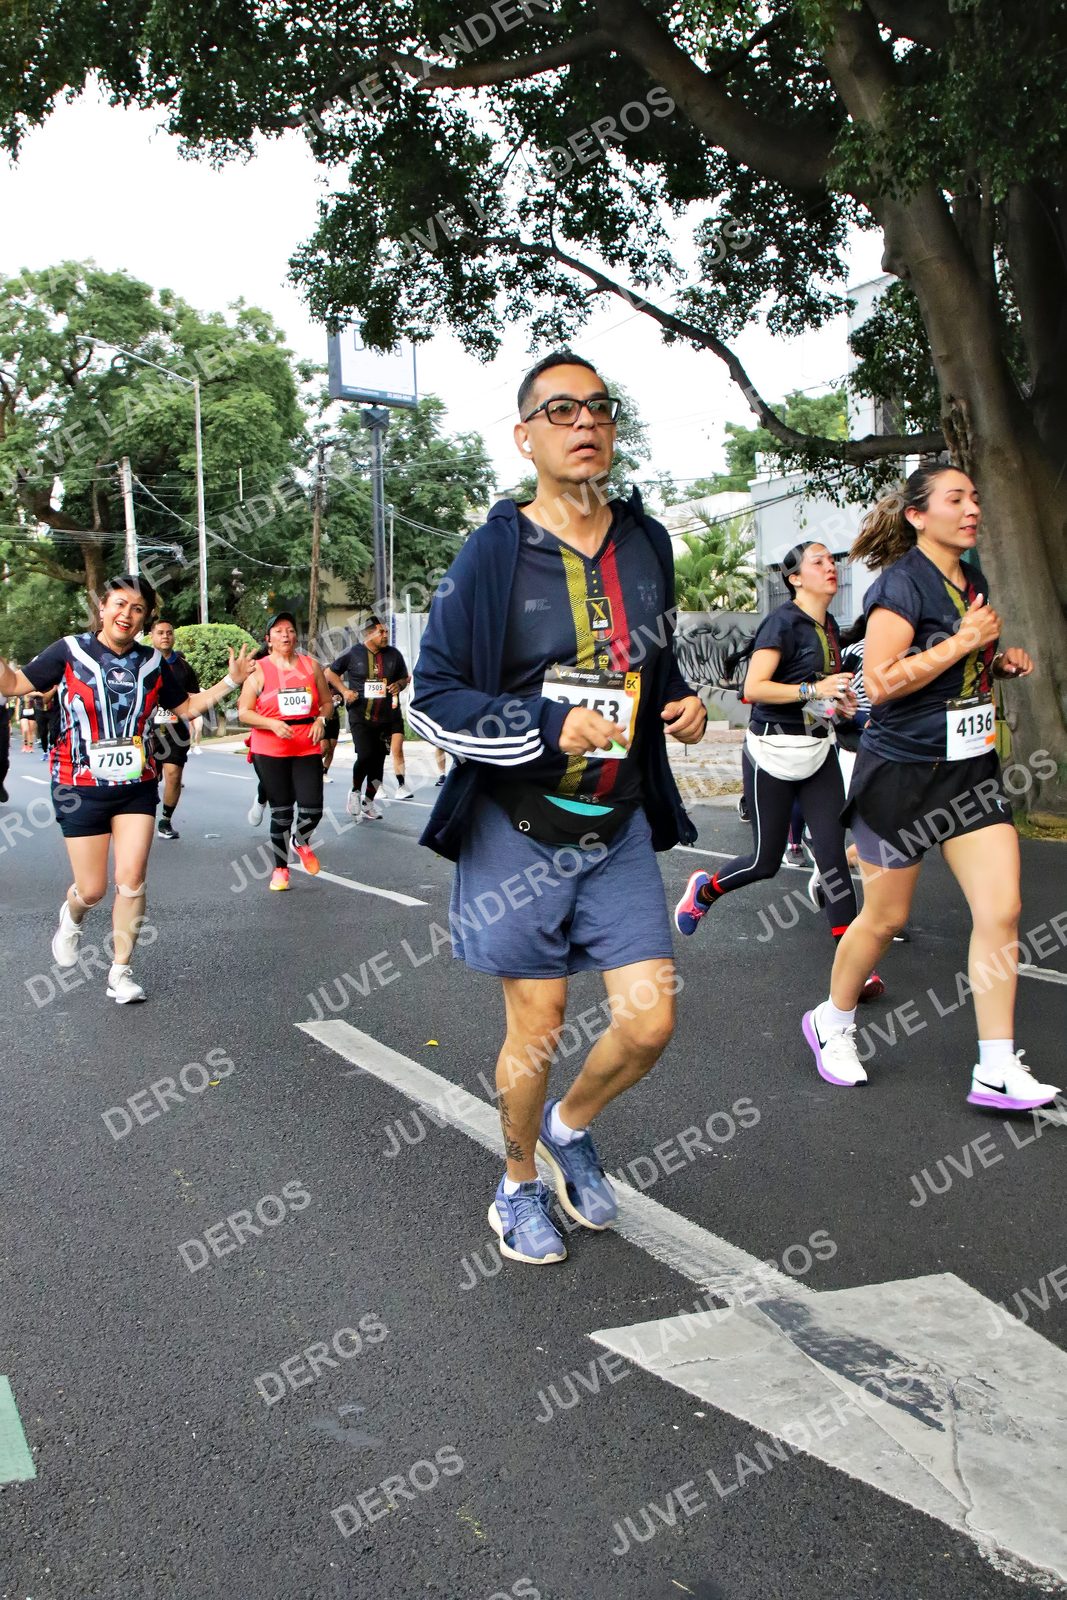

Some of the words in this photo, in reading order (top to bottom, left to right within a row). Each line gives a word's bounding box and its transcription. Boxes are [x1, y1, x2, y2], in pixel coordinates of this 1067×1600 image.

[283, 695, 307, 706] 2004
[956, 711, 992, 737] 4136
[98, 751, 133, 768] 7705
